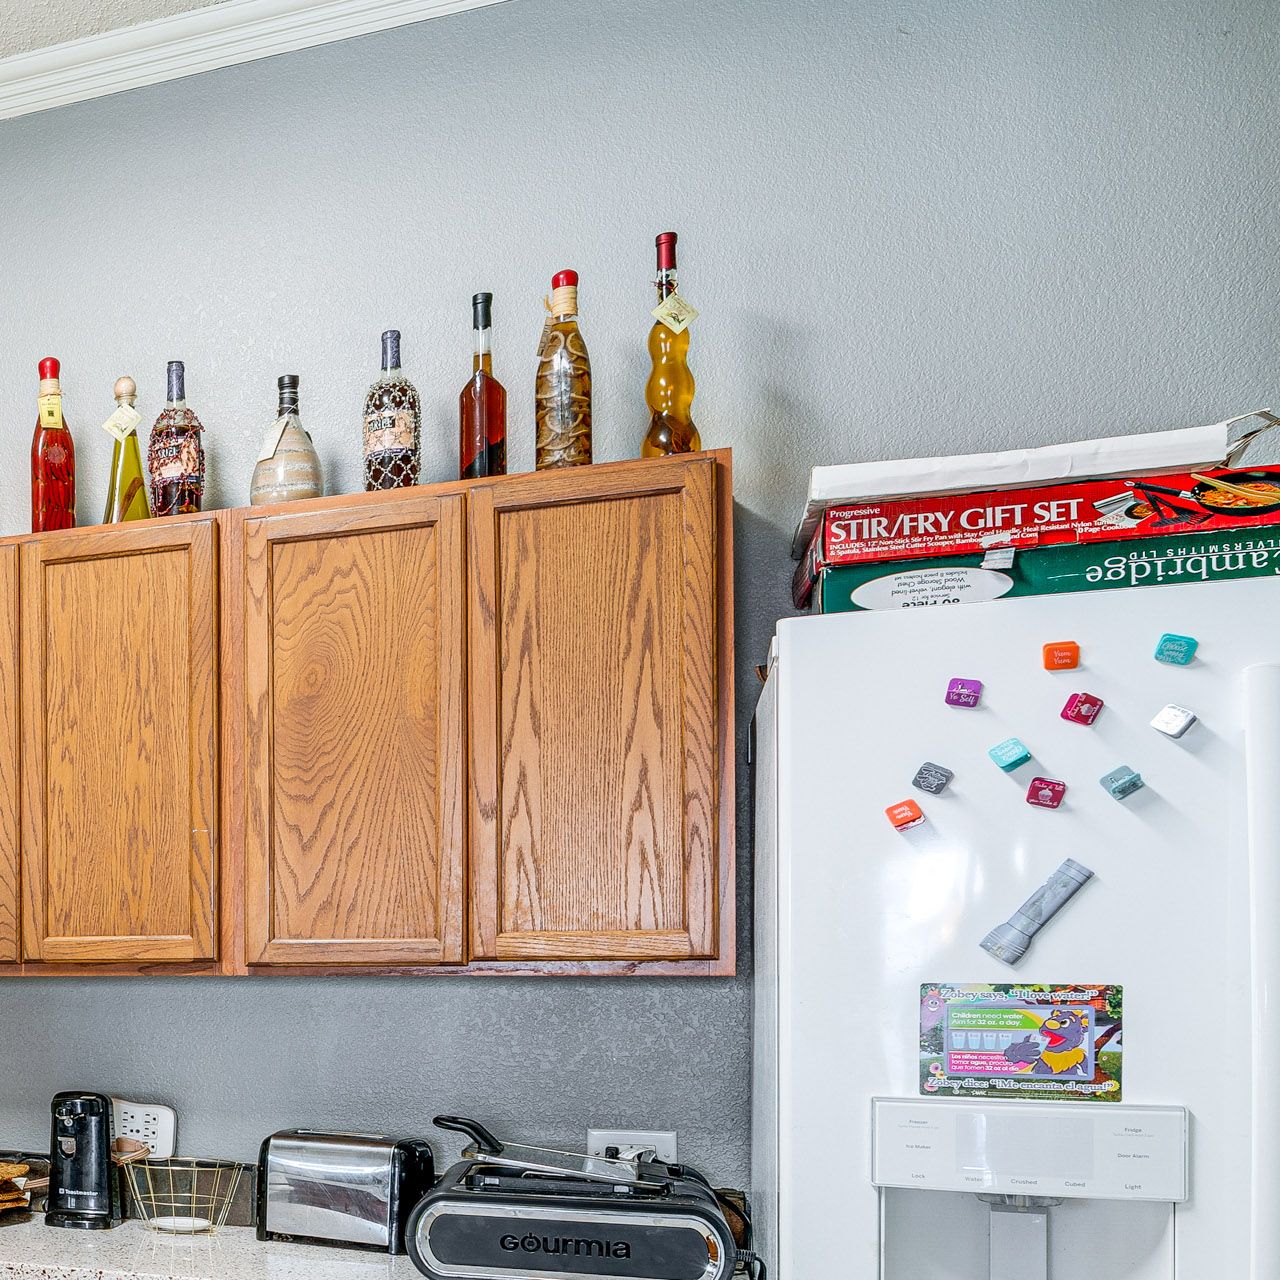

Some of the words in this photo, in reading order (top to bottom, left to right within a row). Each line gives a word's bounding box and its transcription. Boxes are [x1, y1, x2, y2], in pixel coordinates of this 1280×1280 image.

[830, 507, 880, 519] Progressive
[830, 510, 955, 542] STIR/FRY
[959, 504, 1028, 530] GIFT
[1033, 498, 1084, 524] SET
[830, 541, 866, 551] INCLUDES:
[879, 537, 909, 547] Non-Stick
[923, 535, 934, 543] Fry
[964, 530, 978, 539] Stay
[1040, 523, 1070, 532] Resistant
[1071, 520, 1092, 529] Nylon
[862, 544, 889, 553] Stainless
[890, 542, 905, 550] Steel
[906, 541, 926, 549] Cutter
[1129, 550, 1157, 560] LTD
[918, 578, 944, 587] Storage
[959, 694, 976, 705] Self
[941, 989, 977, 1001] Zobey
[980, 991, 1008, 1001] says,
[1024, 990, 1051, 999] love
[928, 1077, 961, 1090] Zobey
[962, 1077, 989, 1088] dice:
[1021, 1082, 1062, 1090] encanta
[1064, 1081, 1076, 1090] el
[65, 1188, 99, 1196] Toastmaster
